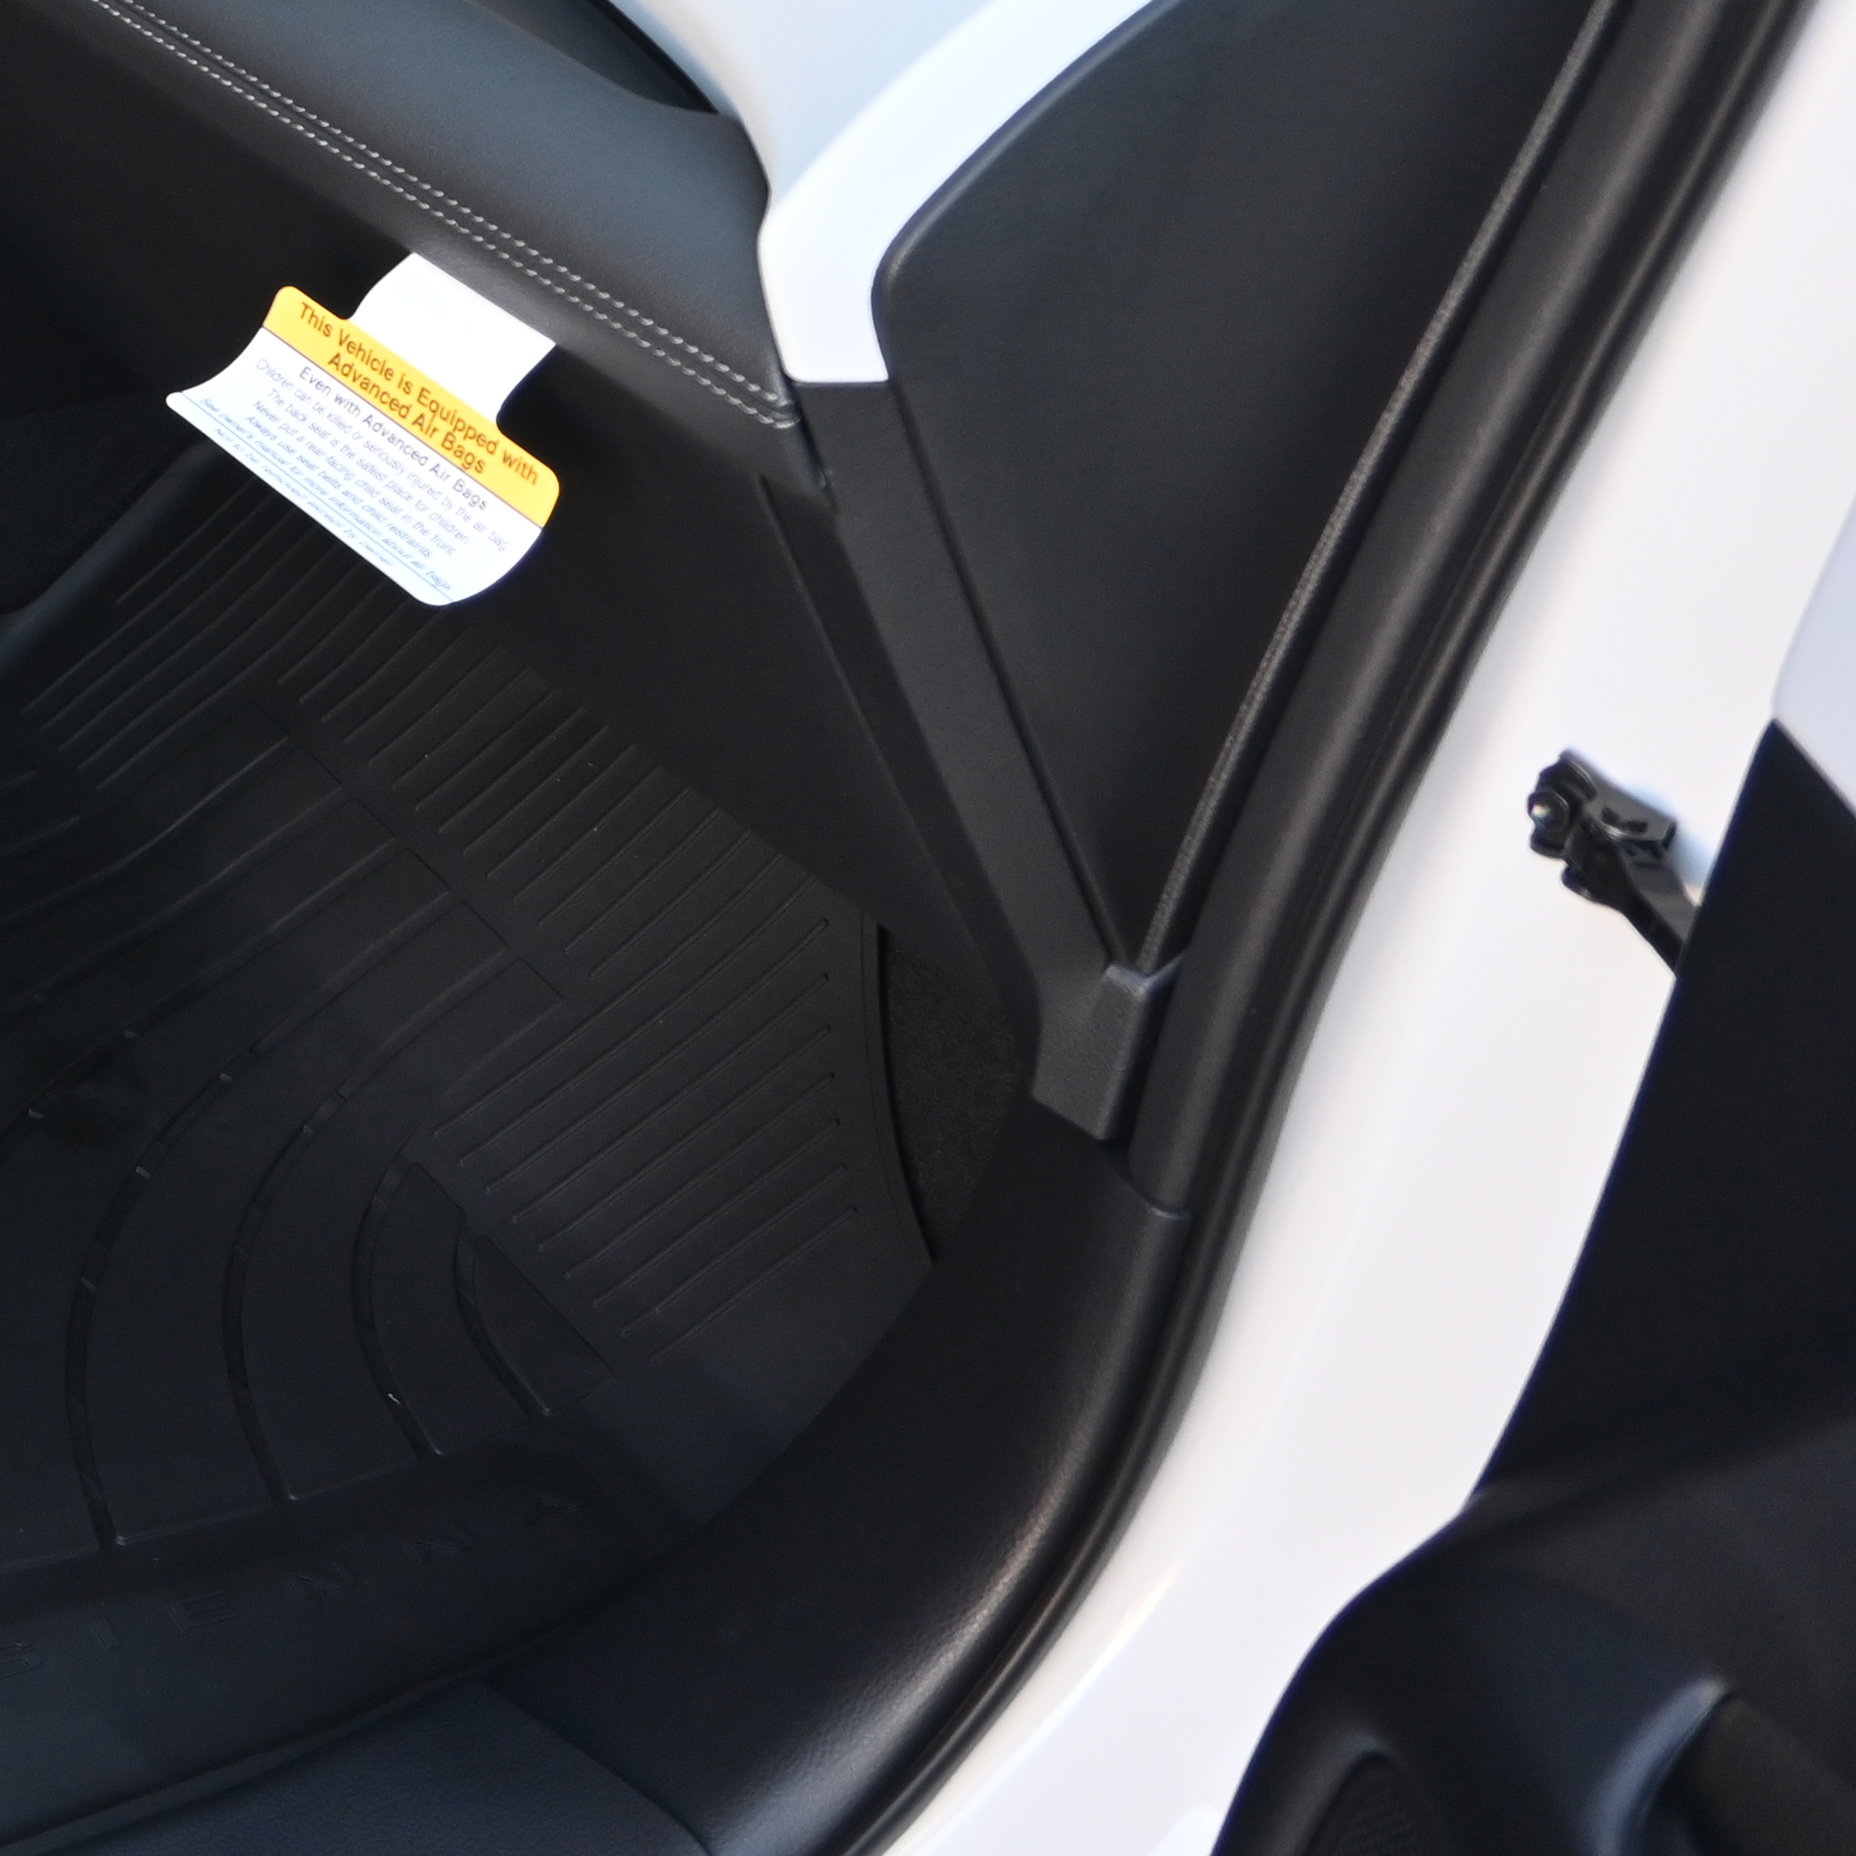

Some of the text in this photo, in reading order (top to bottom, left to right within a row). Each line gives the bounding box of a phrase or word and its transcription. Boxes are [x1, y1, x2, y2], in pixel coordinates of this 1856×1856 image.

[256, 358, 510, 552] Children can be killed or seriously injured by the air bag
[268, 388, 284, 406] The
[285, 404, 307, 422] back
[309, 422, 332, 439] seat
[330, 438, 340, 448] is
[340, 444, 357, 460] the
[356, 457, 388, 481] safest
[384, 479, 413, 502] place
[414, 499, 429, 512] for
[299, 302, 539, 485] This Vehicle is Equipped with
[299, 366, 487, 510] Even with Advanced Air Bags
[328, 352, 485, 474] Advanced Air Bags
[200, 398, 220, 413] See
[219, 412, 256, 440] owner's
[254, 439, 291, 466] manual
[289, 465, 305, 476] for
[329, 491, 384, 538] information
[245, 416, 278, 441] Always
[278, 440, 297, 455] use
[296, 454, 321, 472] seat
[317, 469, 343, 490] belts
[342, 489, 364, 506] and
[361, 504, 388, 523] child
[253, 400, 280, 422] Never
[278, 423, 299, 437] put
[296, 434, 305, 443] a
[305, 441, 356, 481] rear-facing
[354, 479, 381, 498] child
[379, 497, 403, 515] seat
[401, 513, 414, 523] in
[412, 521, 431, 536] the
